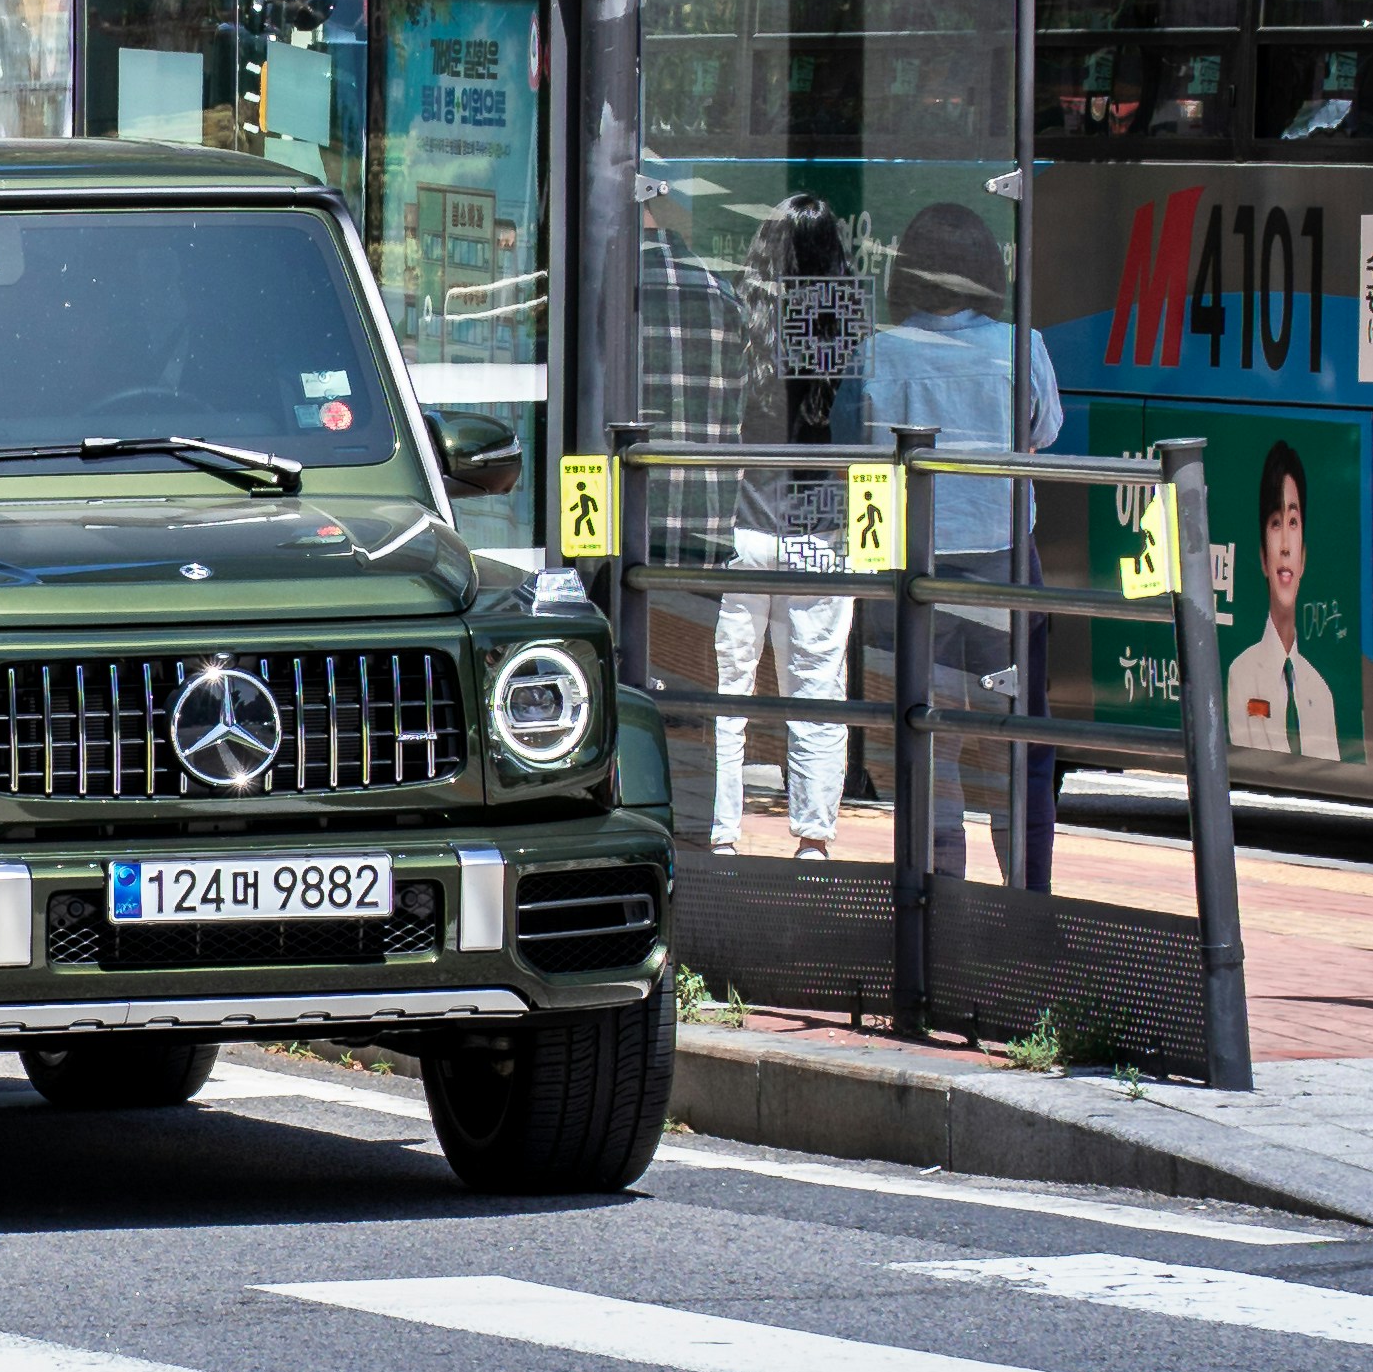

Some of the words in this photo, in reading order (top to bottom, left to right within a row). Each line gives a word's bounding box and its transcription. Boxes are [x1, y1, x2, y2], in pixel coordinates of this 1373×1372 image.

[430, 38, 462, 78] 가벼운
[463, 39, 499, 80] 질환은
[1104, 184, 1325, 374] M4101
[147, 868, 259, 914] 124머
[274, 864, 379, 911] 9882
